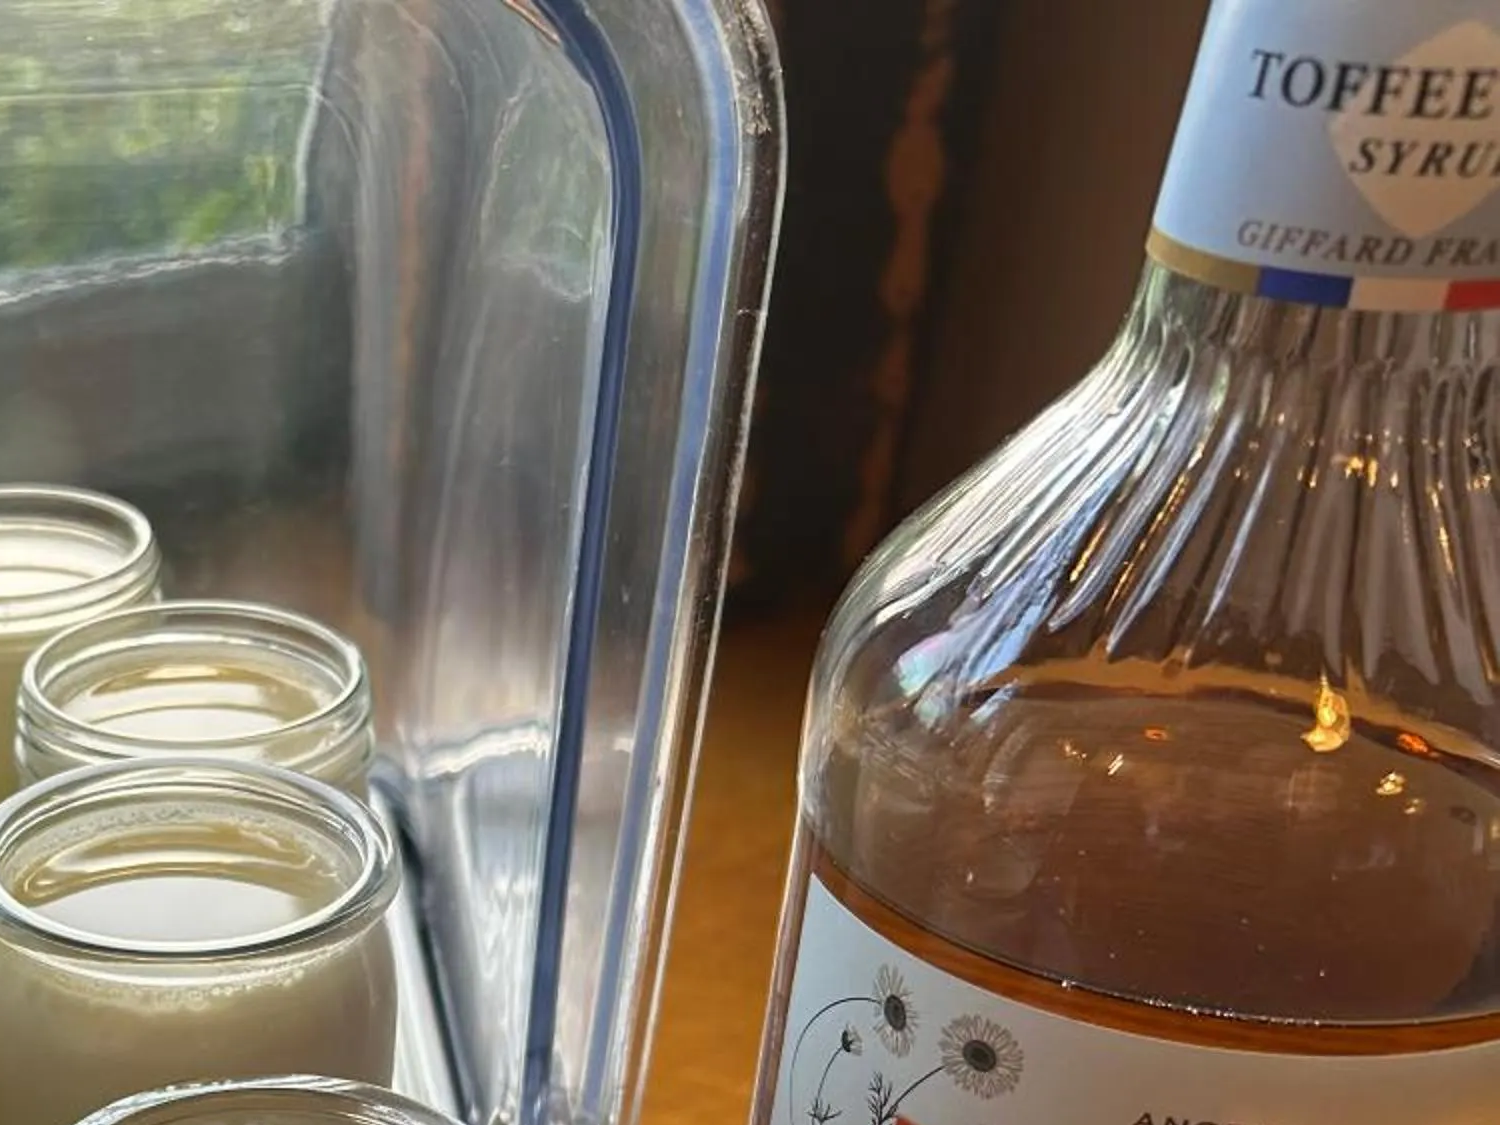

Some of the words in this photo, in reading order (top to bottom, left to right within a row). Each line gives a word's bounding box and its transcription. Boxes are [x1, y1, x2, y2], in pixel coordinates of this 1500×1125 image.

[1248, 48, 1499, 121] TOFFEE
[1348, 137, 1500, 179] SYRU
[1236, 219, 1415, 266] GIFFARD
